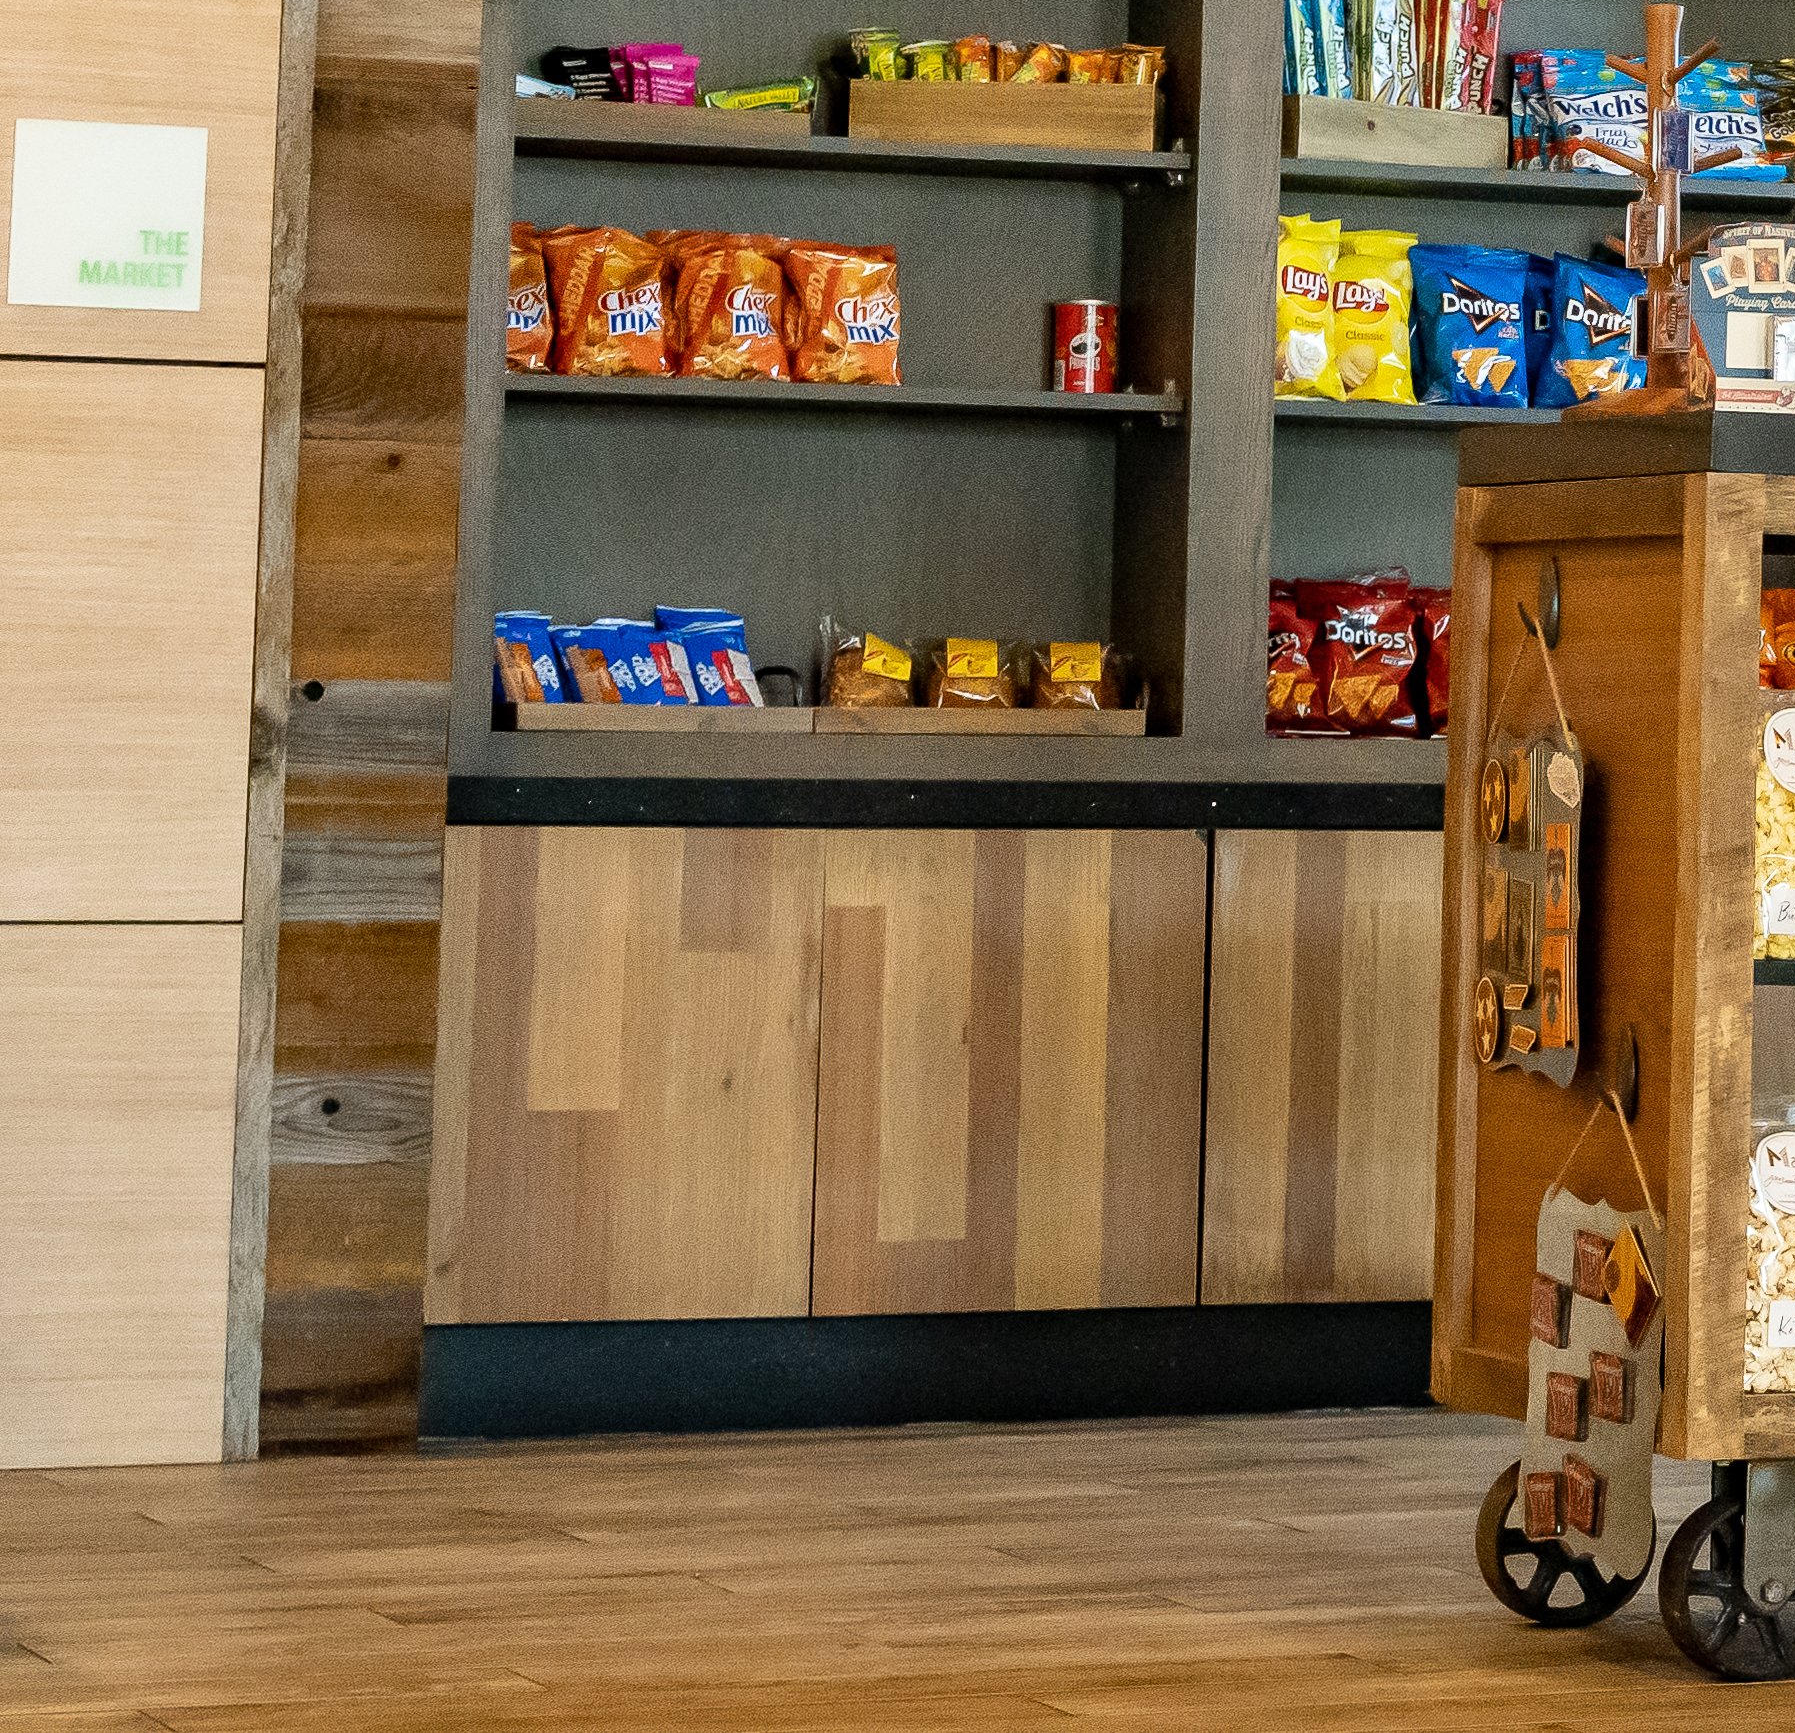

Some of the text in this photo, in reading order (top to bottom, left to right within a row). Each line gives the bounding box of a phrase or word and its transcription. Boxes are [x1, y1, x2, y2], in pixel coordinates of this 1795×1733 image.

[1556, 88, 1647, 119] Welch's
[1695, 115, 1758, 135] elch's
[140, 230, 189, 256] THE
[1724, 226, 1751, 238] SPIRIT
[1753, 226, 1763, 235] OF
[79, 260, 187, 288] MARKET
[1286, 267, 1328, 298] Lay's
[599, 284, 660, 312] Chex
[725, 286, 776, 313] Chex
[837, 297, 896, 324] Chex
[1443, 293, 1520, 321] Doritos
[1726, 294, 1769, 311] Playing
[611, 311, 660, 335] mix
[735, 313, 775, 335] mix
[848, 325, 897, 344] mix
[1346, 330, 1386, 342] Classic
[1325, 620, 1407, 649] Doritos
